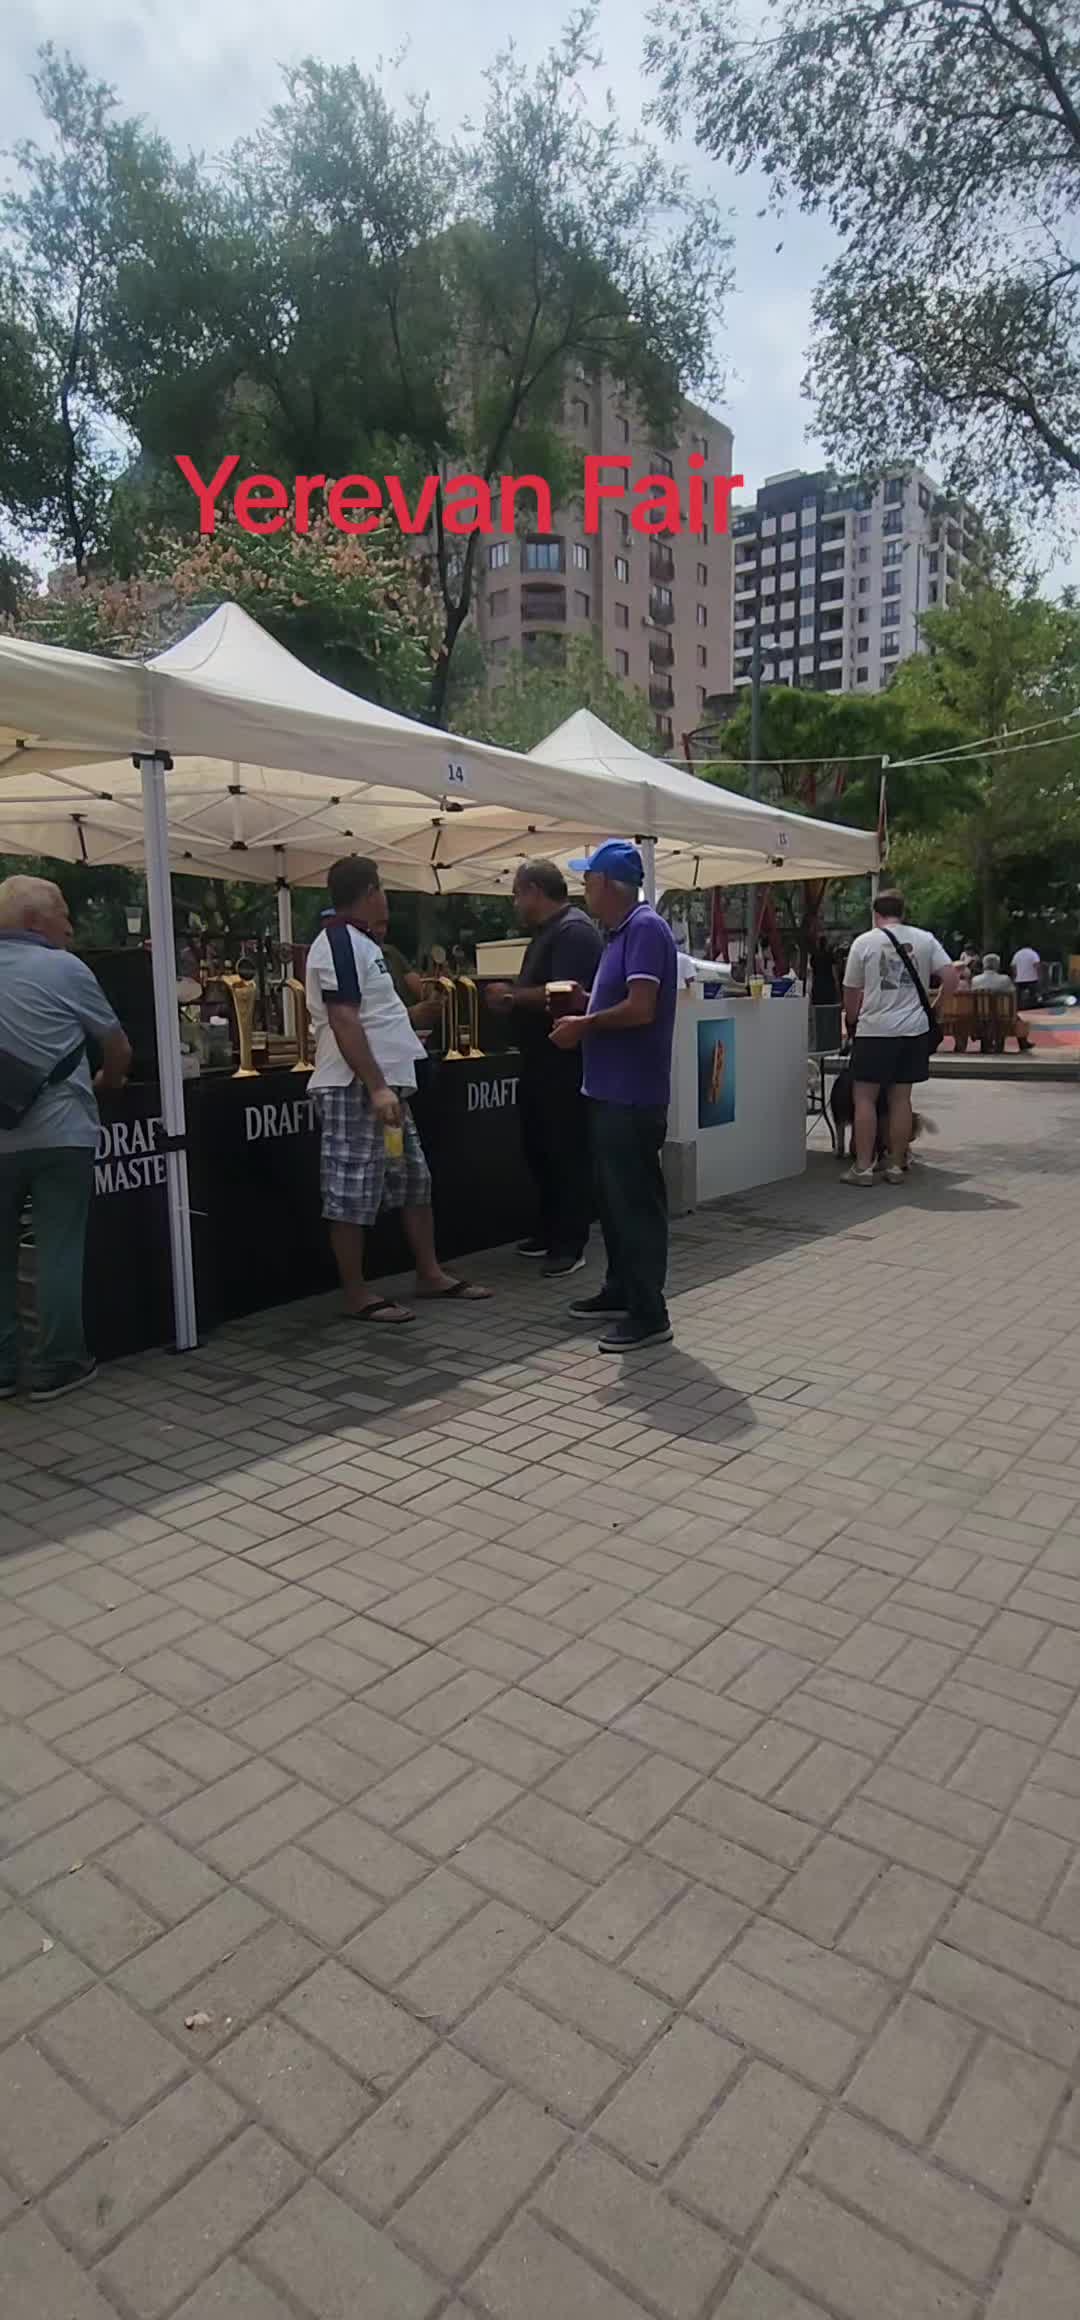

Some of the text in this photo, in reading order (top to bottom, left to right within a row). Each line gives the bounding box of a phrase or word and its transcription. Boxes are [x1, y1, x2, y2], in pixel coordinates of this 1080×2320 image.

[447, 763, 464, 782] 14
[468, 1077, 520, 1111] DRAFT
[96, 1117, 162, 1160] DRAF
[245, 1100, 316, 1140] DRAFT
[95, 1155, 166, 1195] MASTE
